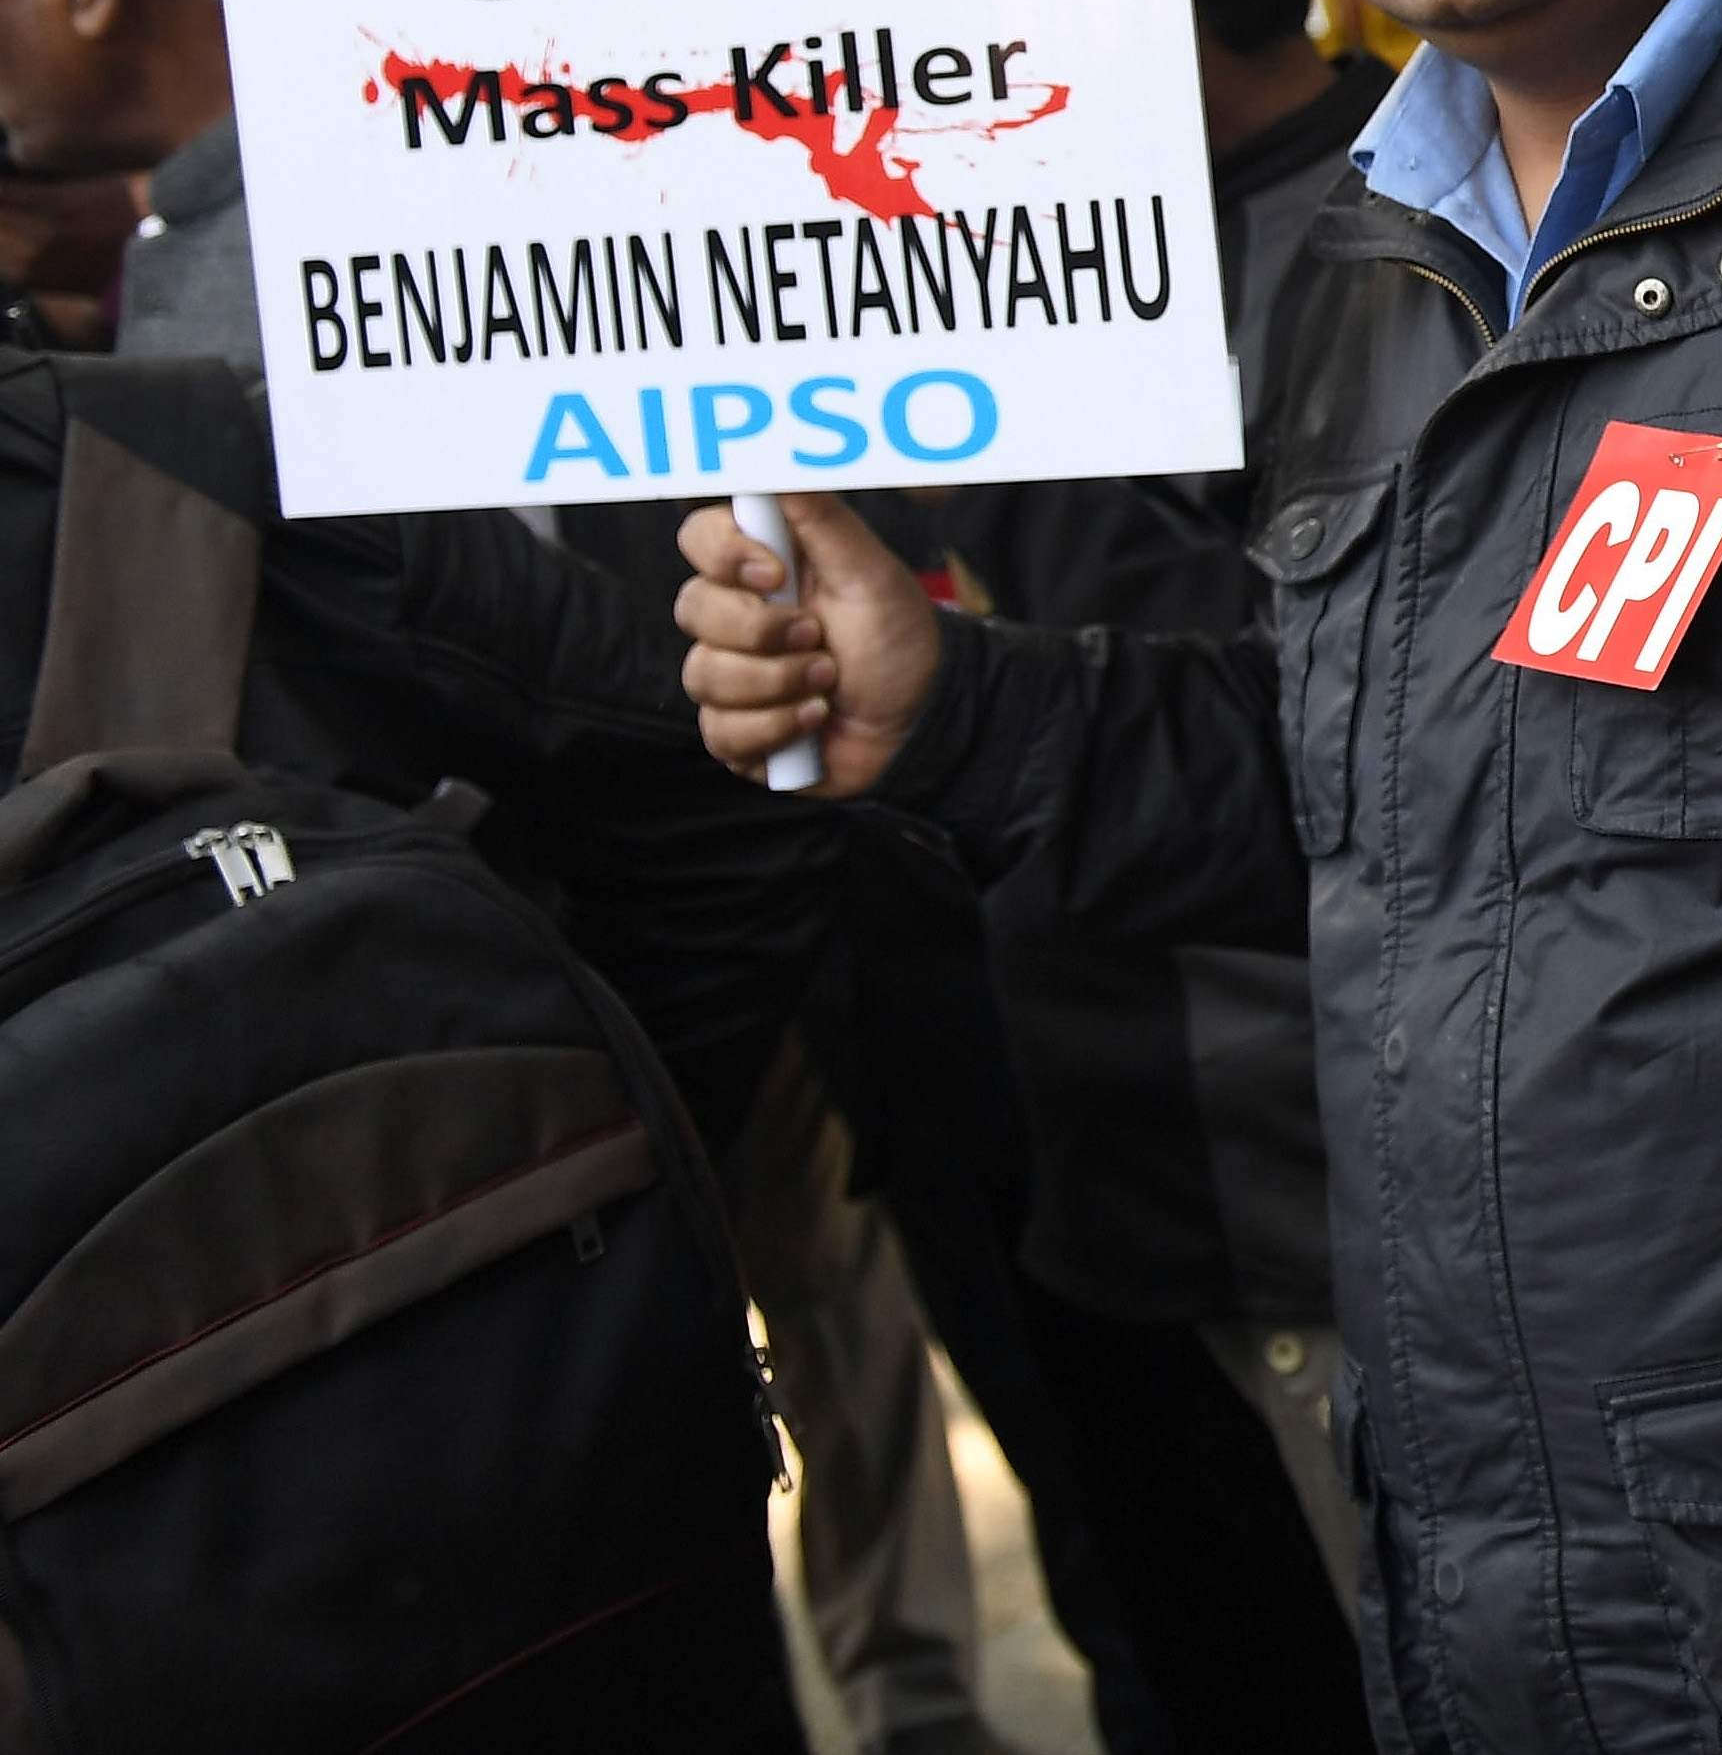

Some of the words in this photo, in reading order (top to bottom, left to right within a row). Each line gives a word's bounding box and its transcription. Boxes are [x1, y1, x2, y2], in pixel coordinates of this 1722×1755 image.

[400, 65, 690, 151] Mass
[727, 26, 1029, 123] Killer
[300, 231, 685, 373] BENJAMIN
[705, 194, 1174, 346] NETANYAHU
[523, 367, 999, 483] AIPSO
